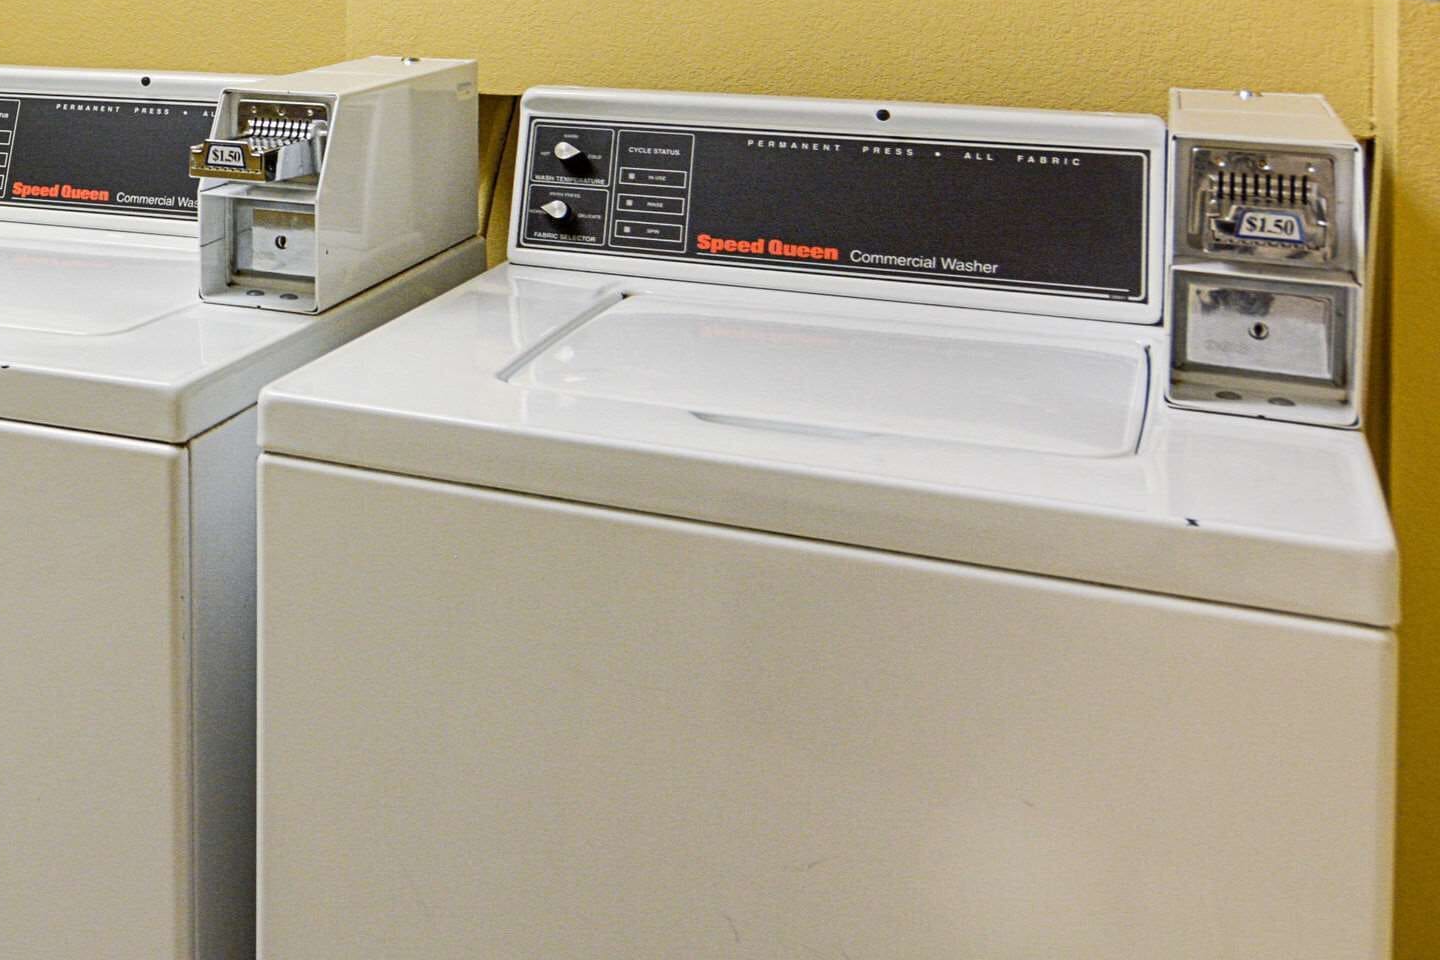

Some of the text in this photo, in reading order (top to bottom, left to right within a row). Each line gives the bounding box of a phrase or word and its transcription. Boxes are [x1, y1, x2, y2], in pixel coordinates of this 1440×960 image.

[56, 103, 216, 118] PERMANENT PRESS AL
[212, 149, 241, 163] $1.50
[628, 146, 681, 157] CYCLE STATUS
[747, 139, 1080, 166] PERMANENT PRESS ALL FABRIC
[12, 181, 199, 209] Speed Queen Commercial Was
[1246, 216, 1295, 236] $1.50
[696, 233, 999, 274] Speed Queen Commercial Washer
